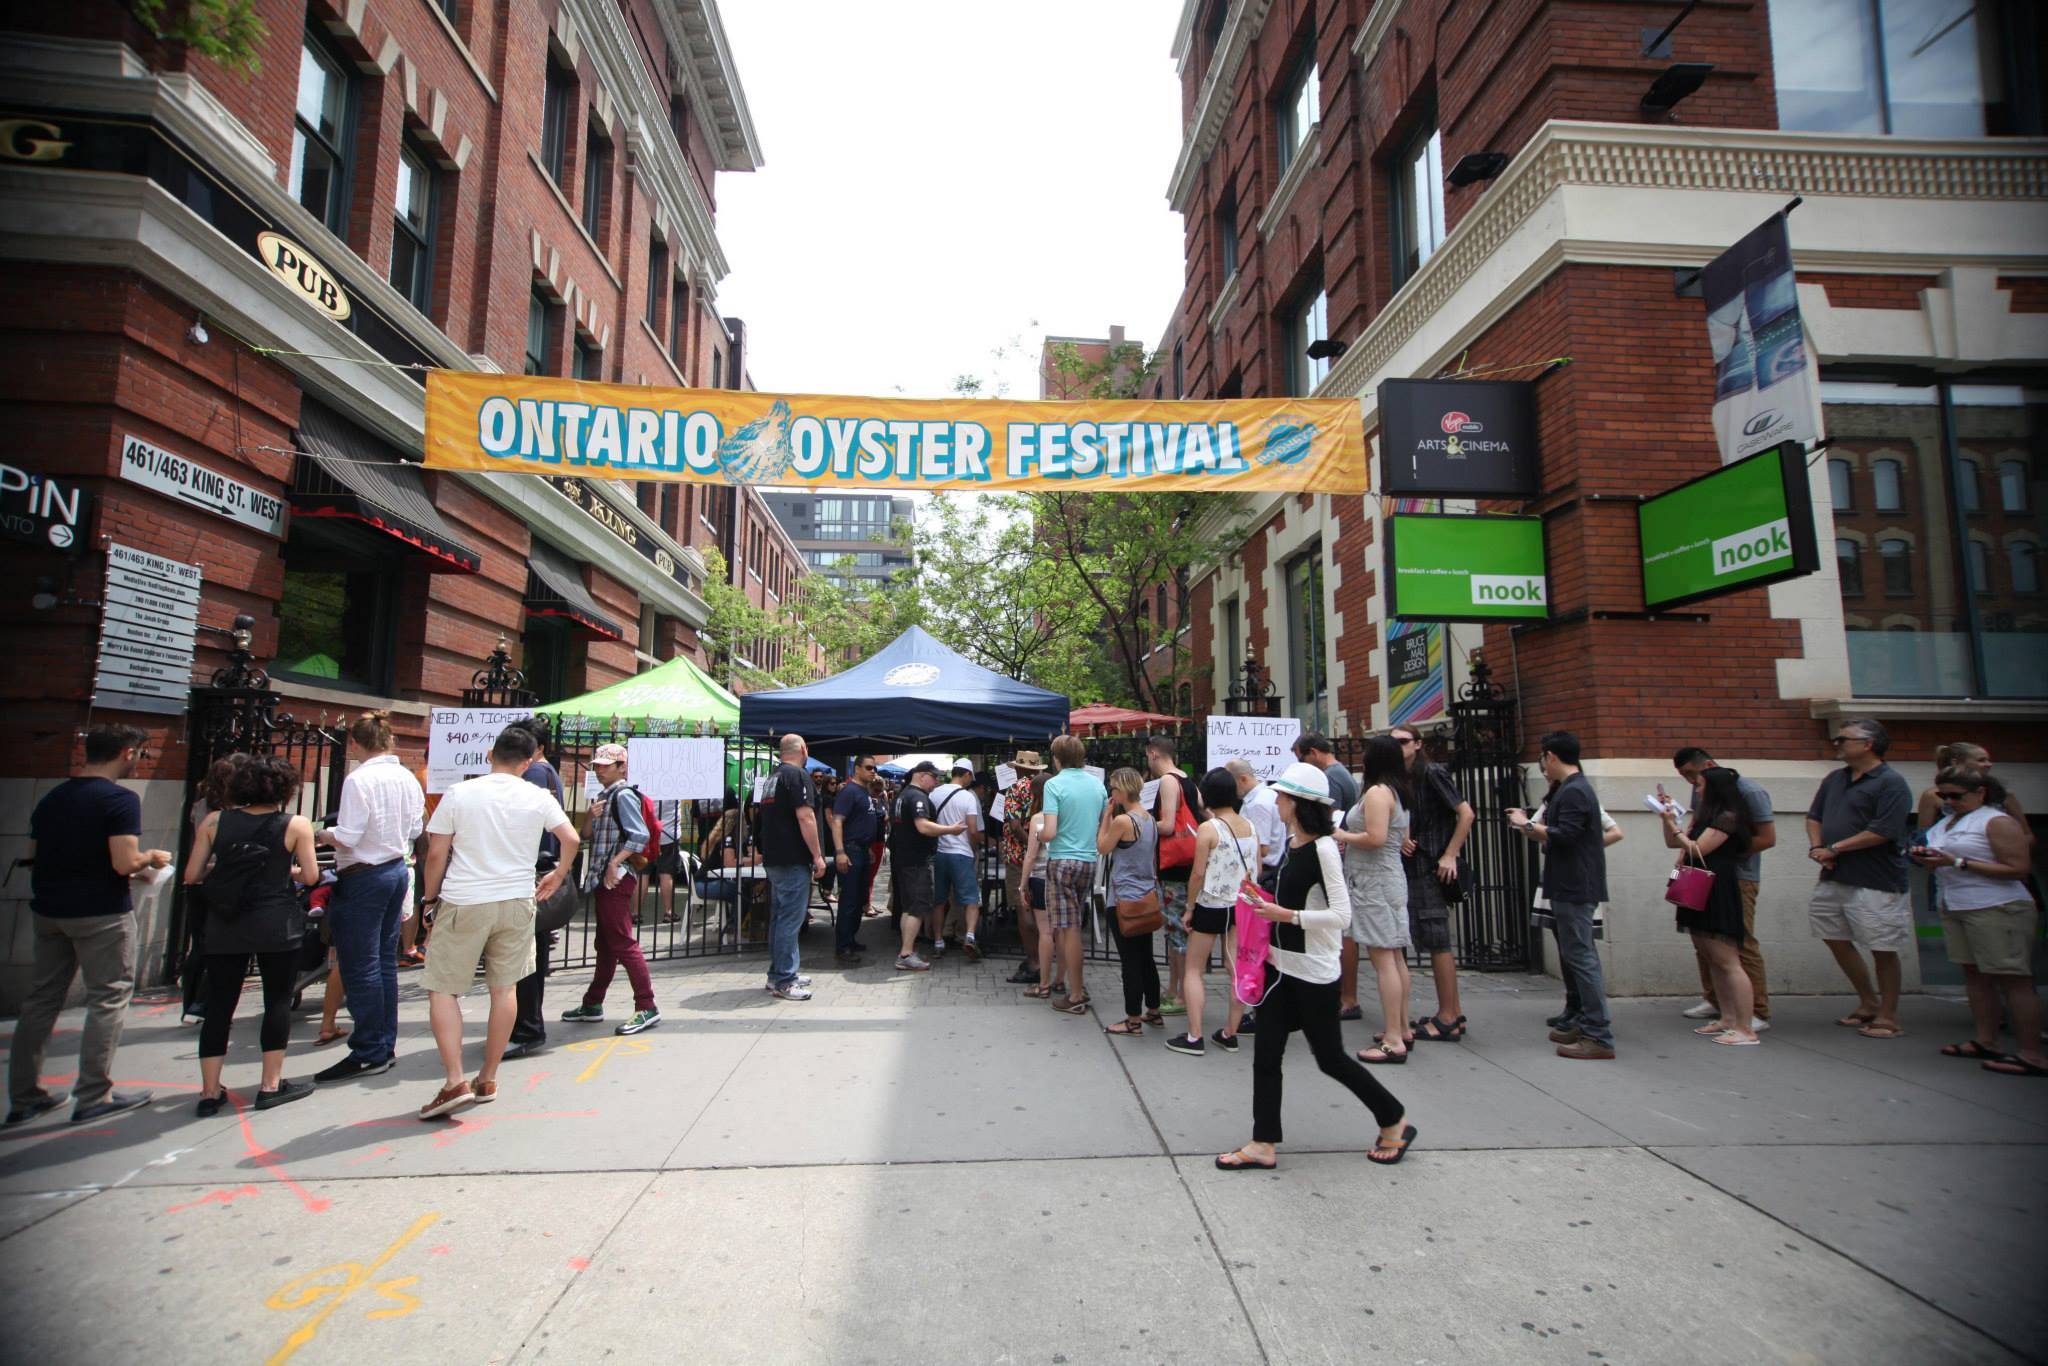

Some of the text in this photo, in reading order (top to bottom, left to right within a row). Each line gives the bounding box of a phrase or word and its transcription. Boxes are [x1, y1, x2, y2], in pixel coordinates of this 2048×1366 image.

[275, 241, 338, 311] PUB
[479, 397, 1246, 479] ONTARIO OYSTER FESTIVAL
[126, 441, 283, 524] 461/463 KING ST. WEST
[590, 495, 637, 545] KING
[1720, 526, 1789, 568] nook
[114, 548, 198, 579] 461/463 KING ST. WEST
[659, 551, 672, 572] PUB
[1479, 579, 1541, 601] nook
[1403, 659, 1426, 672] DESIGN
[431, 713, 459, 724] NEED
[466, 712, 474, 724] A
[1208, 721, 1297, 737] HAVE A TICKET?
[1265, 745, 1281, 756] ID
